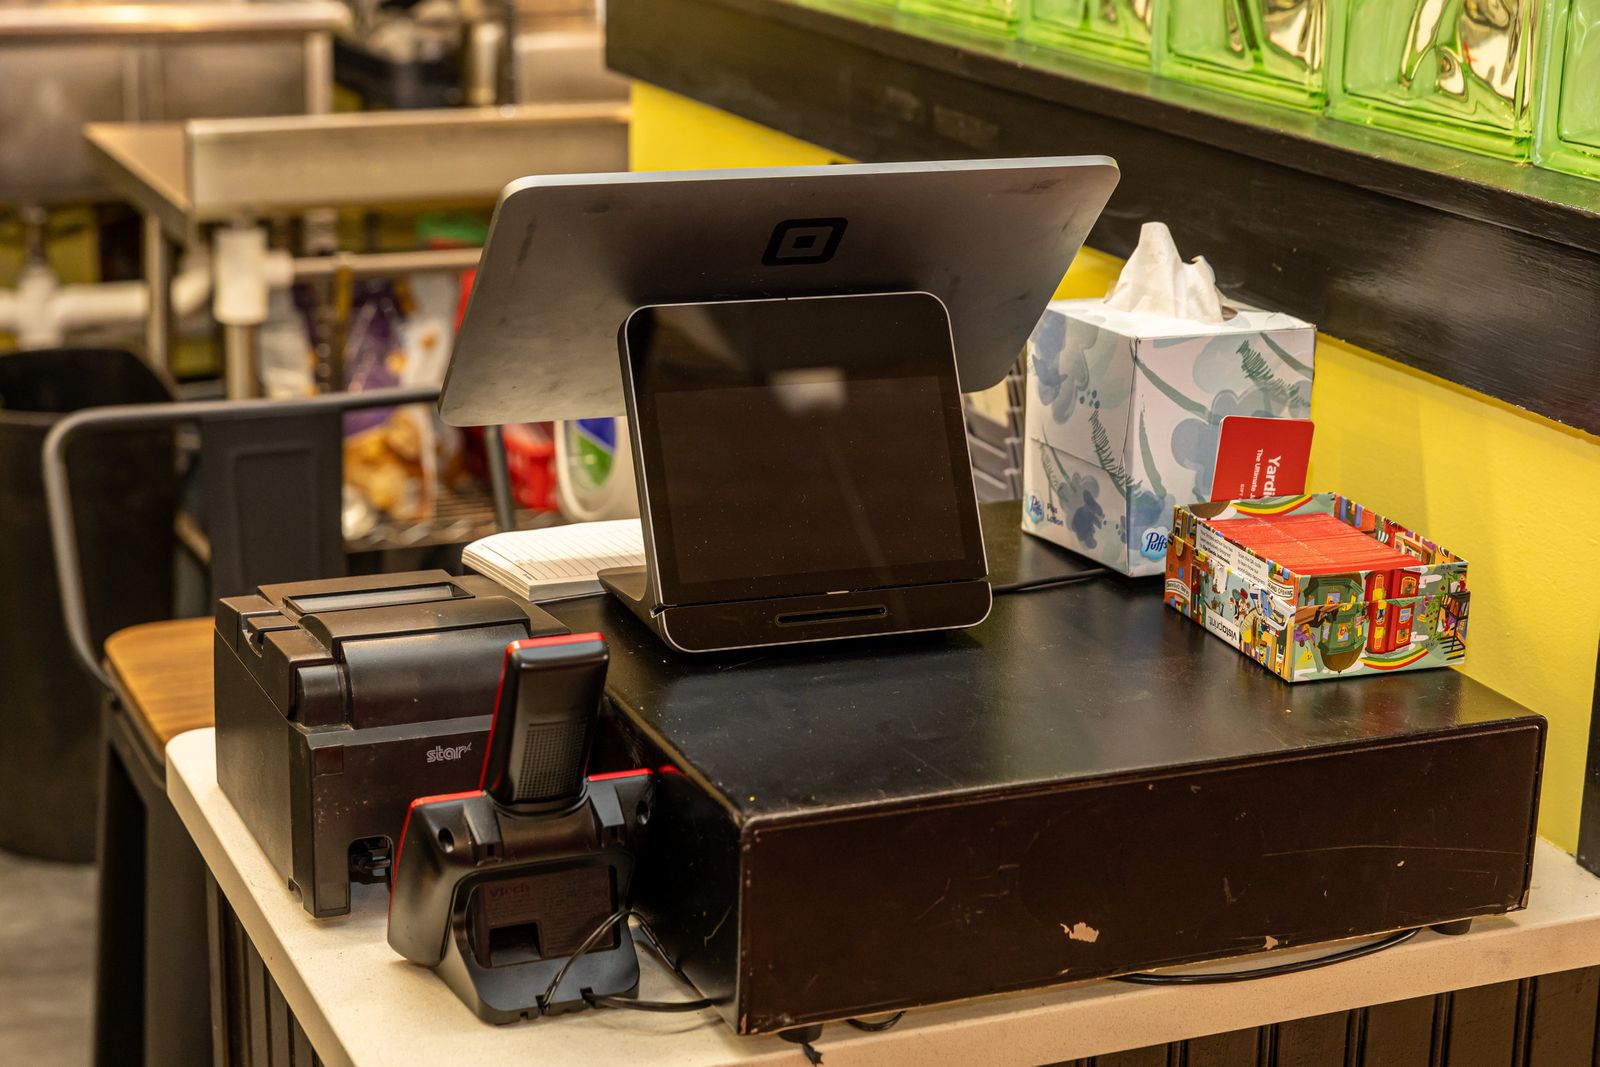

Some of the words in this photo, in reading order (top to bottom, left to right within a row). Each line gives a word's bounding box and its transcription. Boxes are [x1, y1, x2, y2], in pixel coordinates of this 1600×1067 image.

[1255, 448, 1264, 463] The
[1250, 463, 1261, 492] Ultimate
[1263, 455, 1282, 498] Yardi
[1145, 532, 1168, 552] Puffs
[426, 743, 470, 763] star
